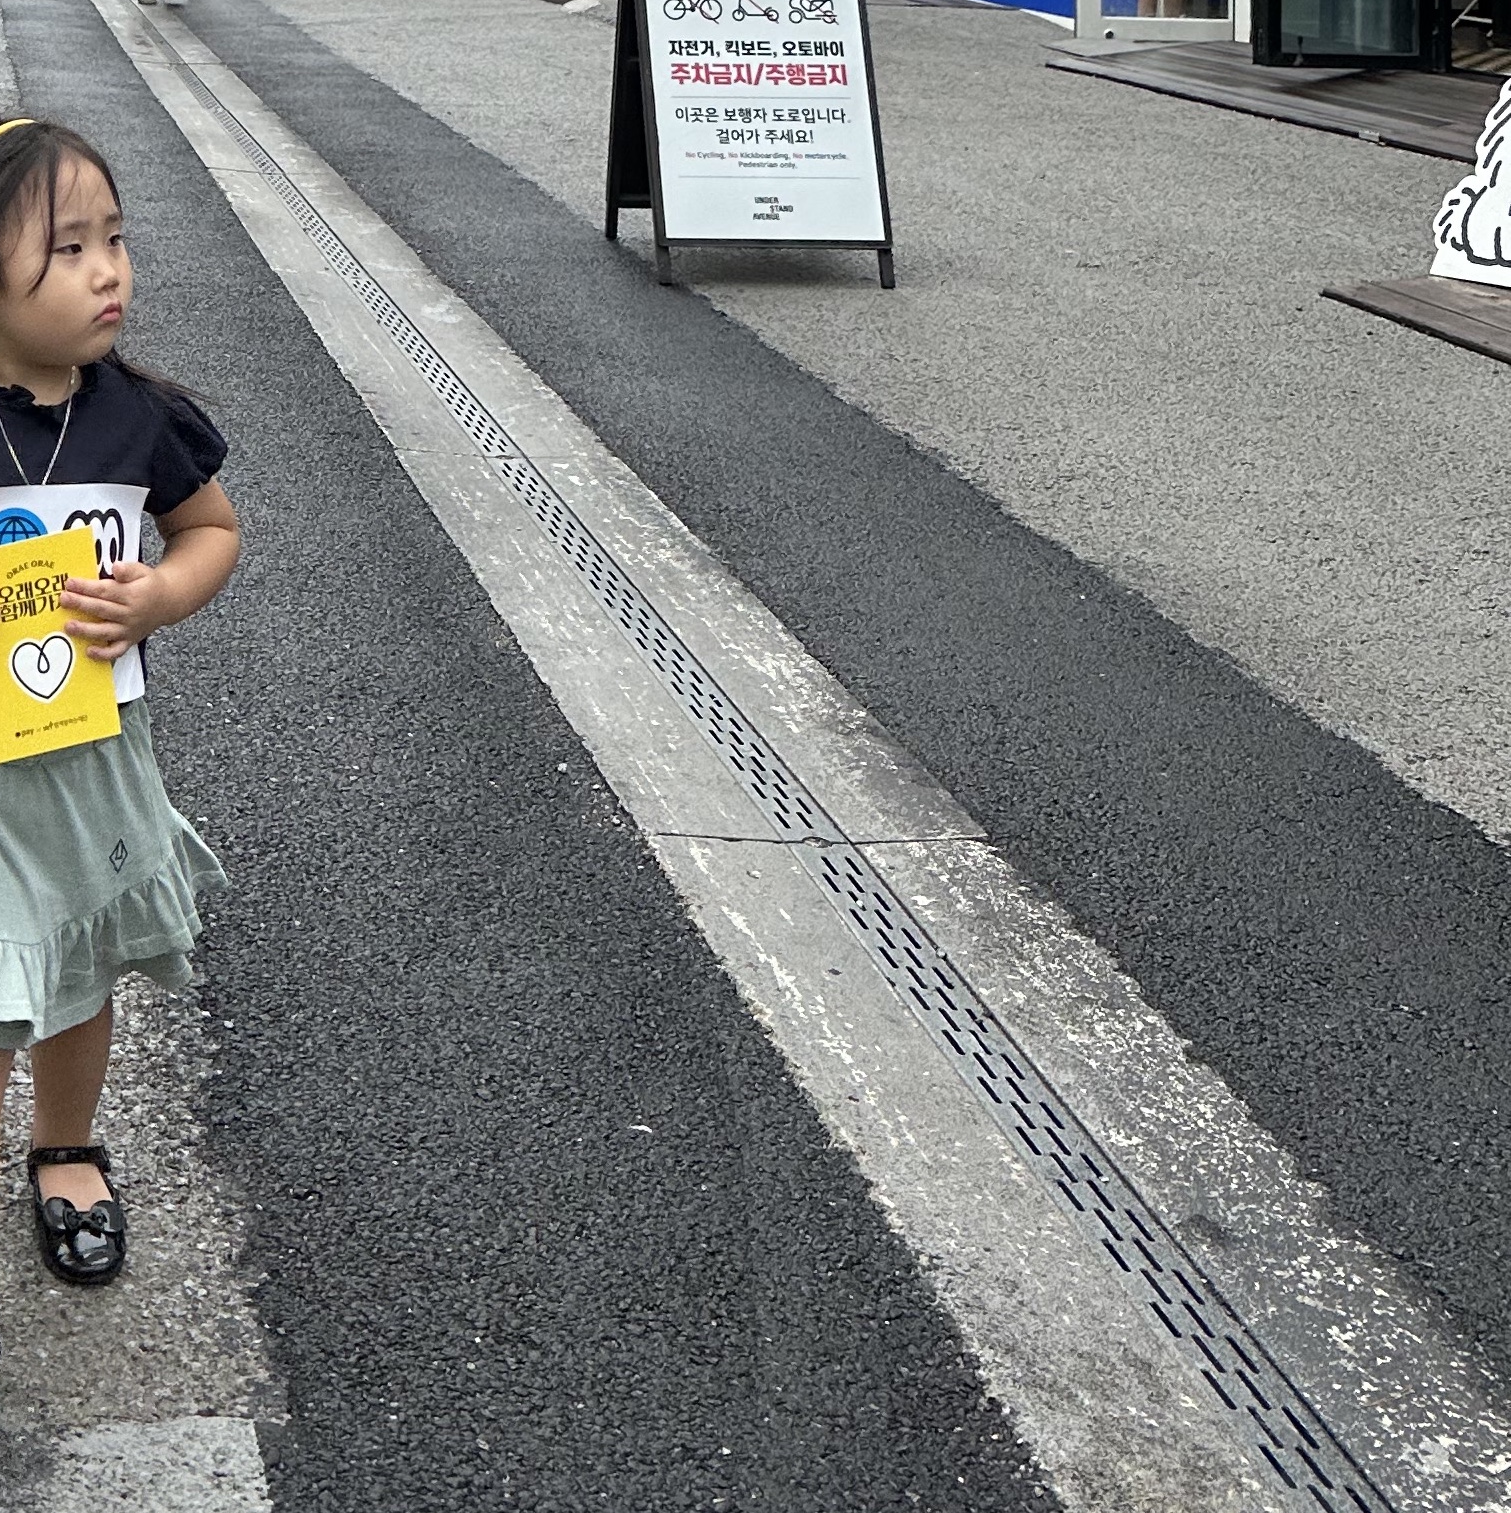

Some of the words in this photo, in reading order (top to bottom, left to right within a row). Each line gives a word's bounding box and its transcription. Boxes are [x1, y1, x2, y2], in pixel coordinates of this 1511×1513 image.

[669, 40, 720, 58] 자전거,
[725, 40, 778, 58] 킥보드,
[782, 40, 845, 57] 오토바이
[670, 63, 848, 86] 주차금지/주행금지
[675, 107, 719, 123] 이곳은
[723, 107, 768, 123] 보행자
[772, 108, 851, 124] 도로입니다.
[716, 129, 760, 145] 걸어가
[765, 129, 814, 145] 주세요!
[769, 205, 794, 213] STAND
[6, 561, 29, 580] ORAE
[30, 559, 55, 569] ORAE
